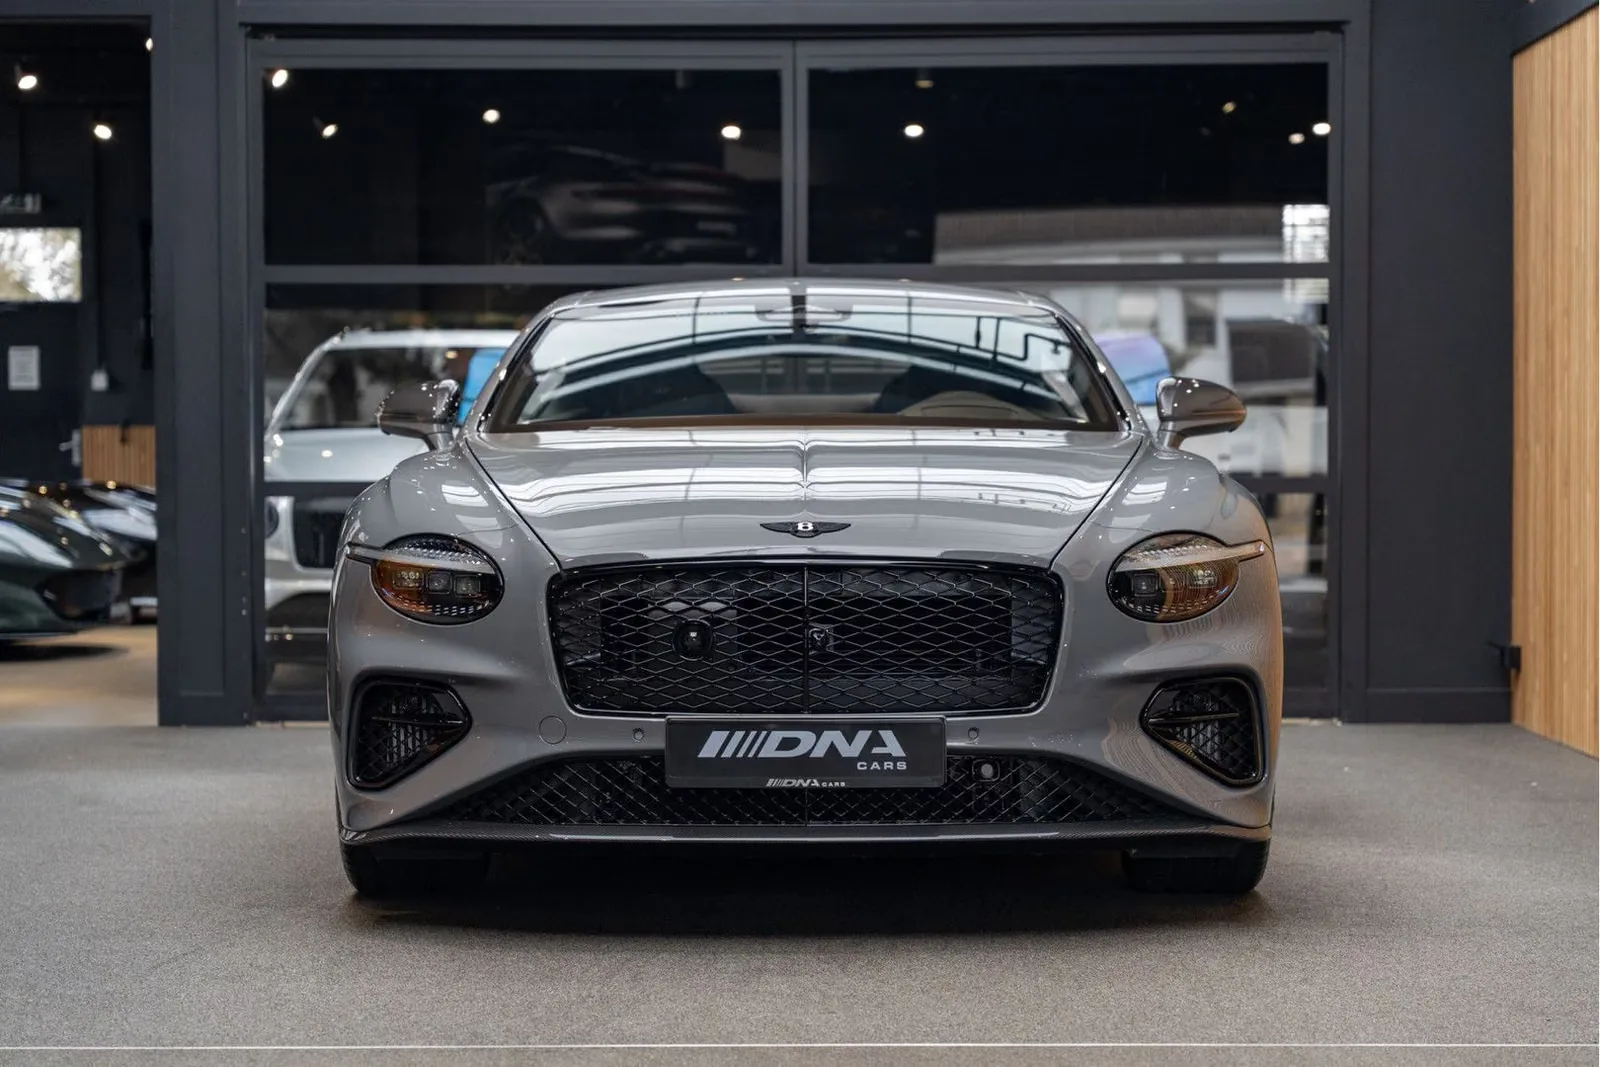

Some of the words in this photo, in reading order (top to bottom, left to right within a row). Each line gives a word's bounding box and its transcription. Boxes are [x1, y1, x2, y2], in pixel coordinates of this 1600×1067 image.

[757, 730, 907, 758] DNA
[856, 761, 907, 770] CARS
[782, 778, 820, 787] DNA
